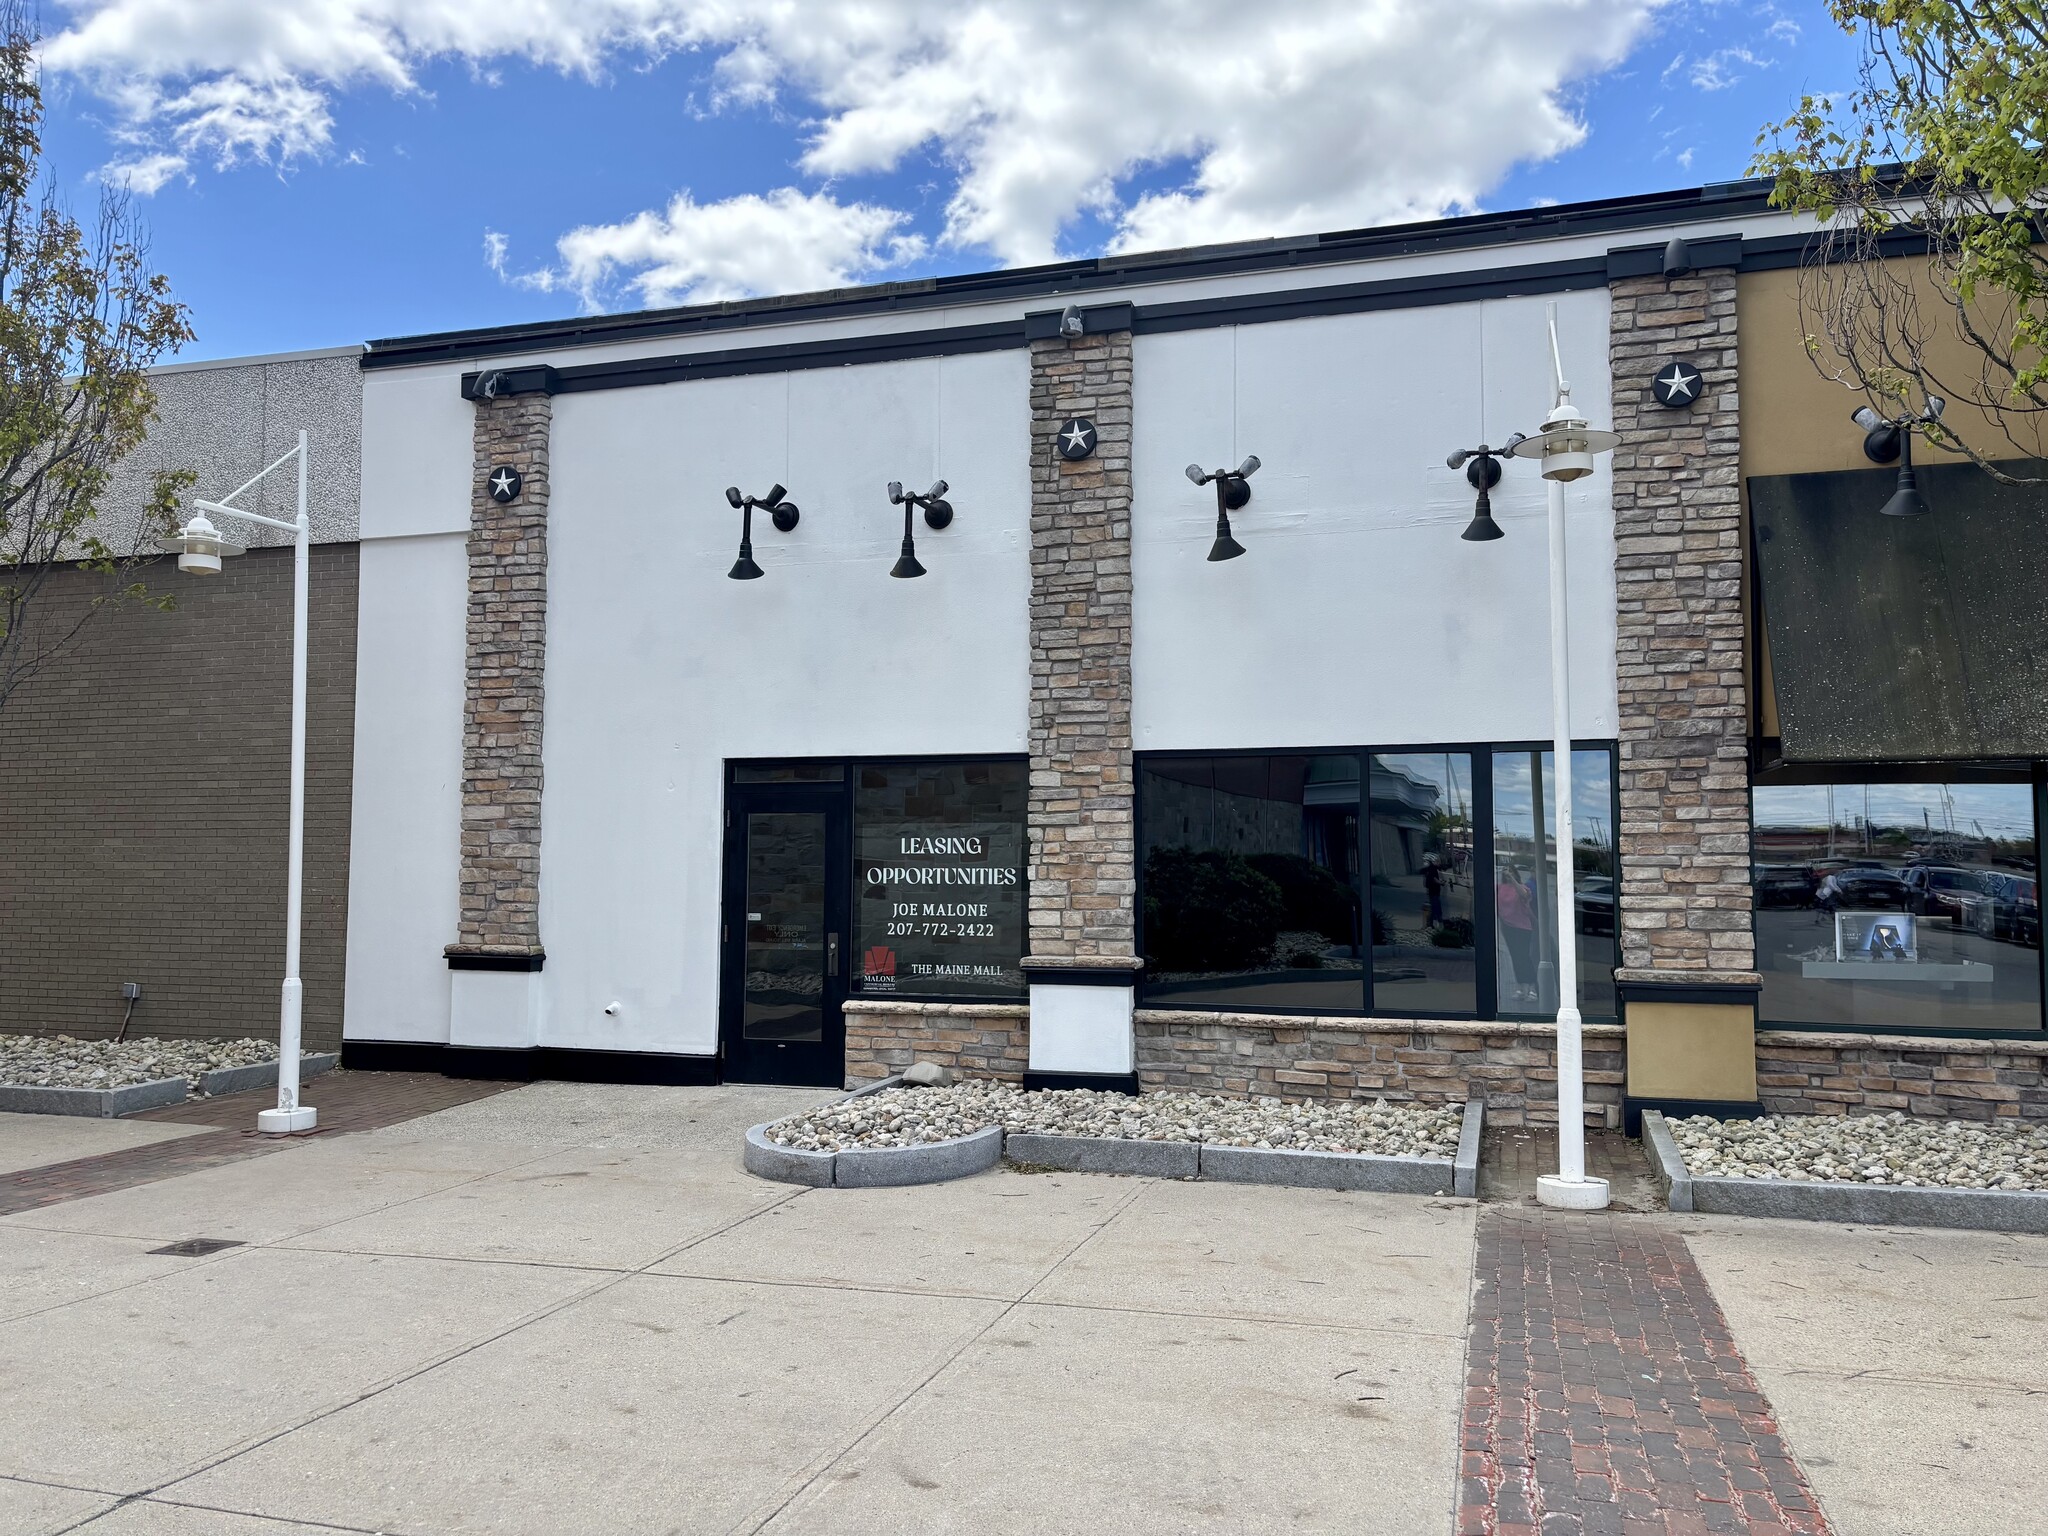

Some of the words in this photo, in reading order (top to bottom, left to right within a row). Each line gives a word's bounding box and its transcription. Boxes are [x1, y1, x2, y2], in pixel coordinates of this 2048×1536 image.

[901, 837, 982, 855] LEASING
[867, 867, 1017, 885] OPPORTUNITIES
[892, 903, 918, 918] JOE
[922, 903, 988, 917] MALONE
[887, 923, 994, 937] 207-772-2422
[911, 964, 933, 974] THE
[935, 965, 970, 975] MAINE
[973, 965, 1003, 976] MALL
[864, 975, 896, 983] MALONE
